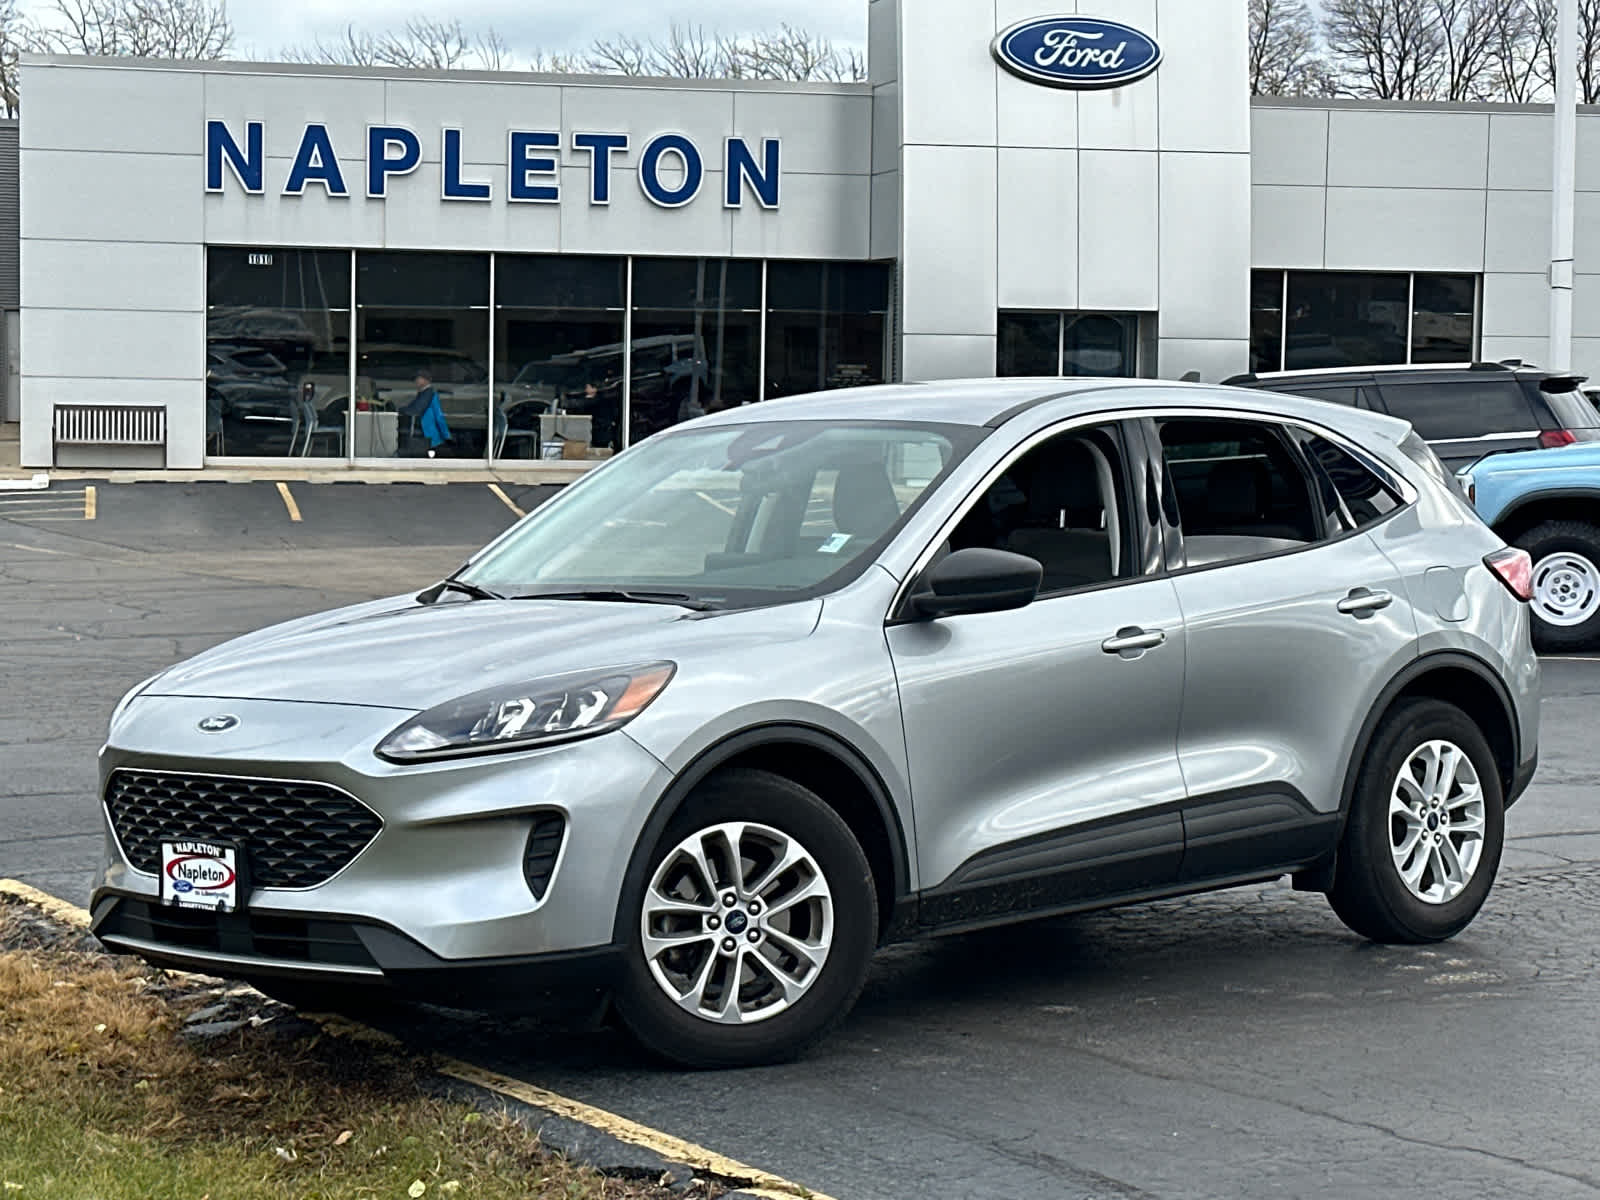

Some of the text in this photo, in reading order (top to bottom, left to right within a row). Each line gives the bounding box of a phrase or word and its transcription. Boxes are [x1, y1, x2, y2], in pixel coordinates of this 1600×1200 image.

[1034, 29, 1127, 69] Ford
[205, 119, 782, 209] NAPLETON
[176, 843, 219, 856] NAPLETON
[178, 862, 225, 882] Napleton
